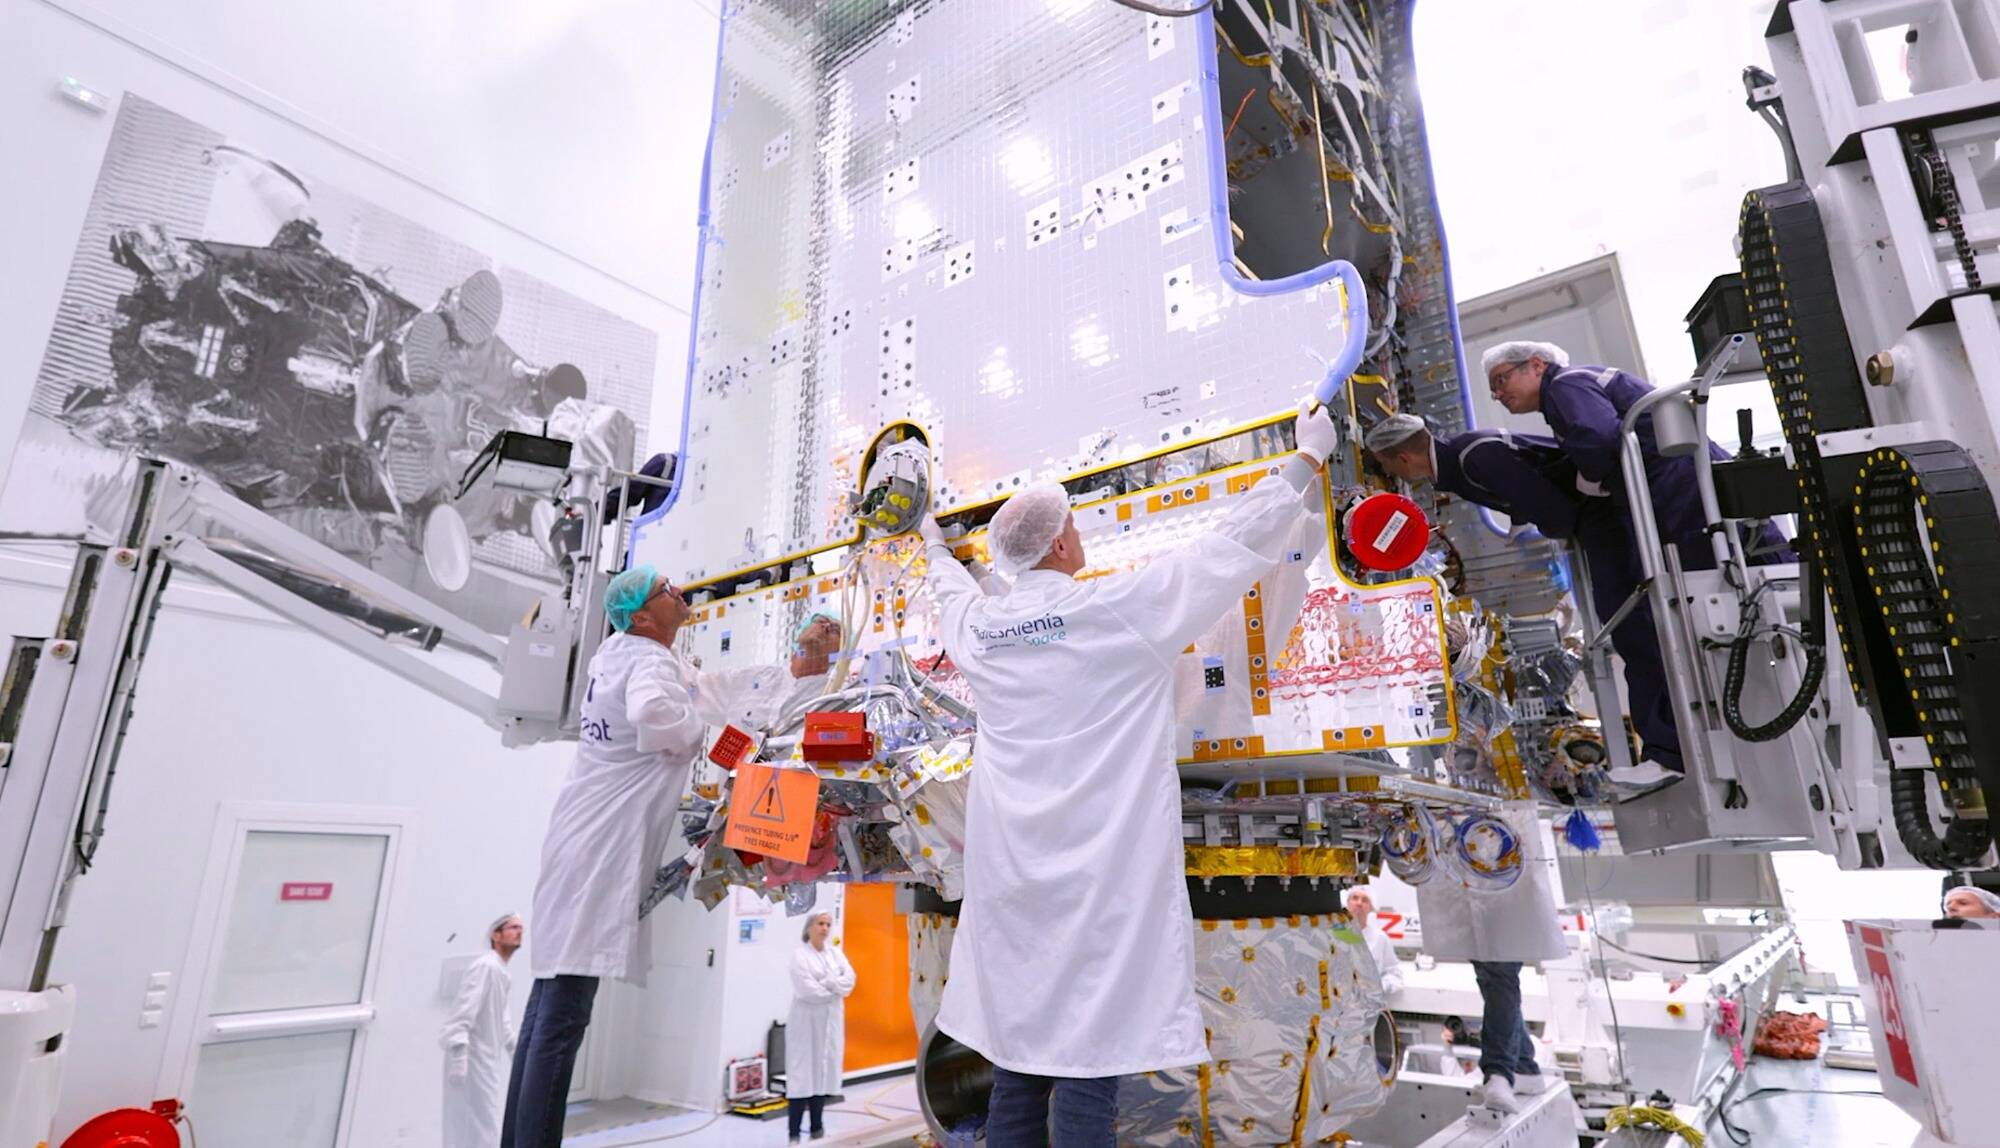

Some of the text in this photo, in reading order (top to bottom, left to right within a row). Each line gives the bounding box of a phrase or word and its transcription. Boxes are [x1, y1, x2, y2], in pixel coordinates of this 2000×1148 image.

[1023, 631, 1066, 647] Space
[762, 827, 784, 839] TUBING
[758, 839, 780, 851] FRAGILE
